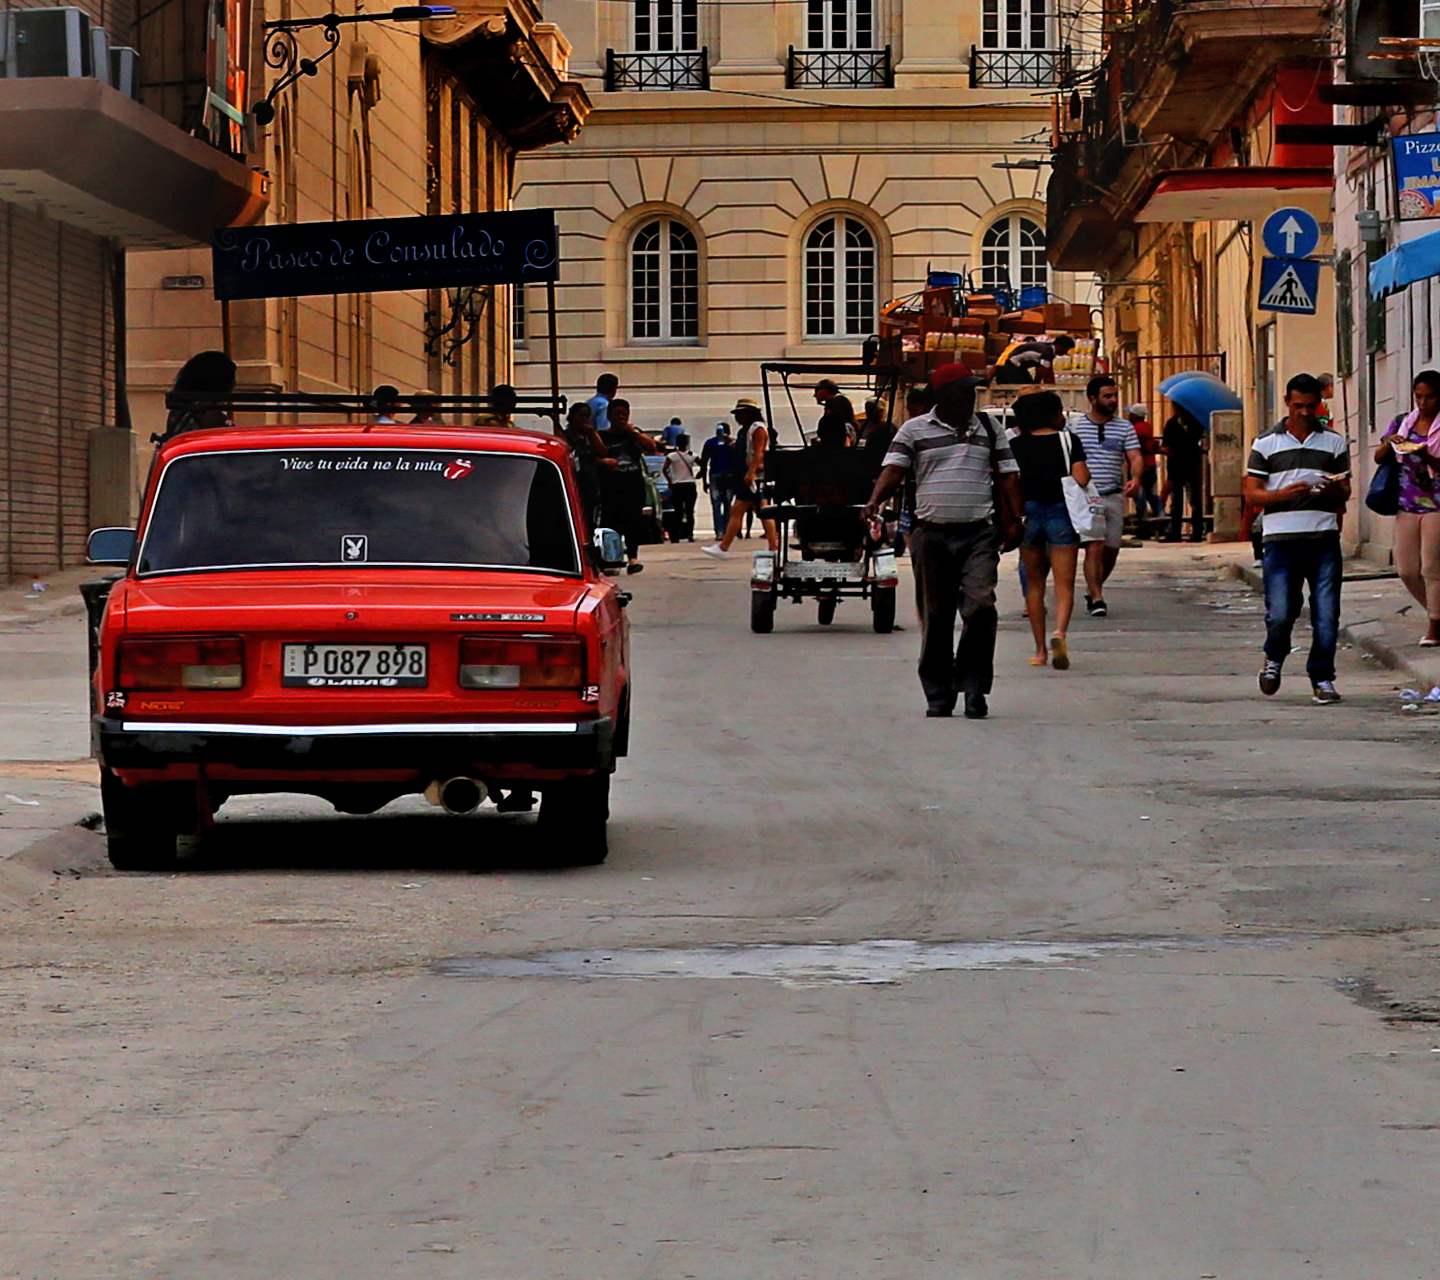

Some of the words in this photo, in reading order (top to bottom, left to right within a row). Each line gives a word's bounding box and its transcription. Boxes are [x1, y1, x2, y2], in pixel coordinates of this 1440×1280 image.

[242, 237, 323, 272] Paseo
[330, 239, 354, 266] de
[365, 226, 505, 264] Consulado
[280, 457, 314, 470] Vive
[317, 459, 332, 470] tu
[335, 456, 368, 470] vida
[372, 461, 393, 470] no
[395, 456, 412, 470] la
[377, 650, 423, 675] 898
